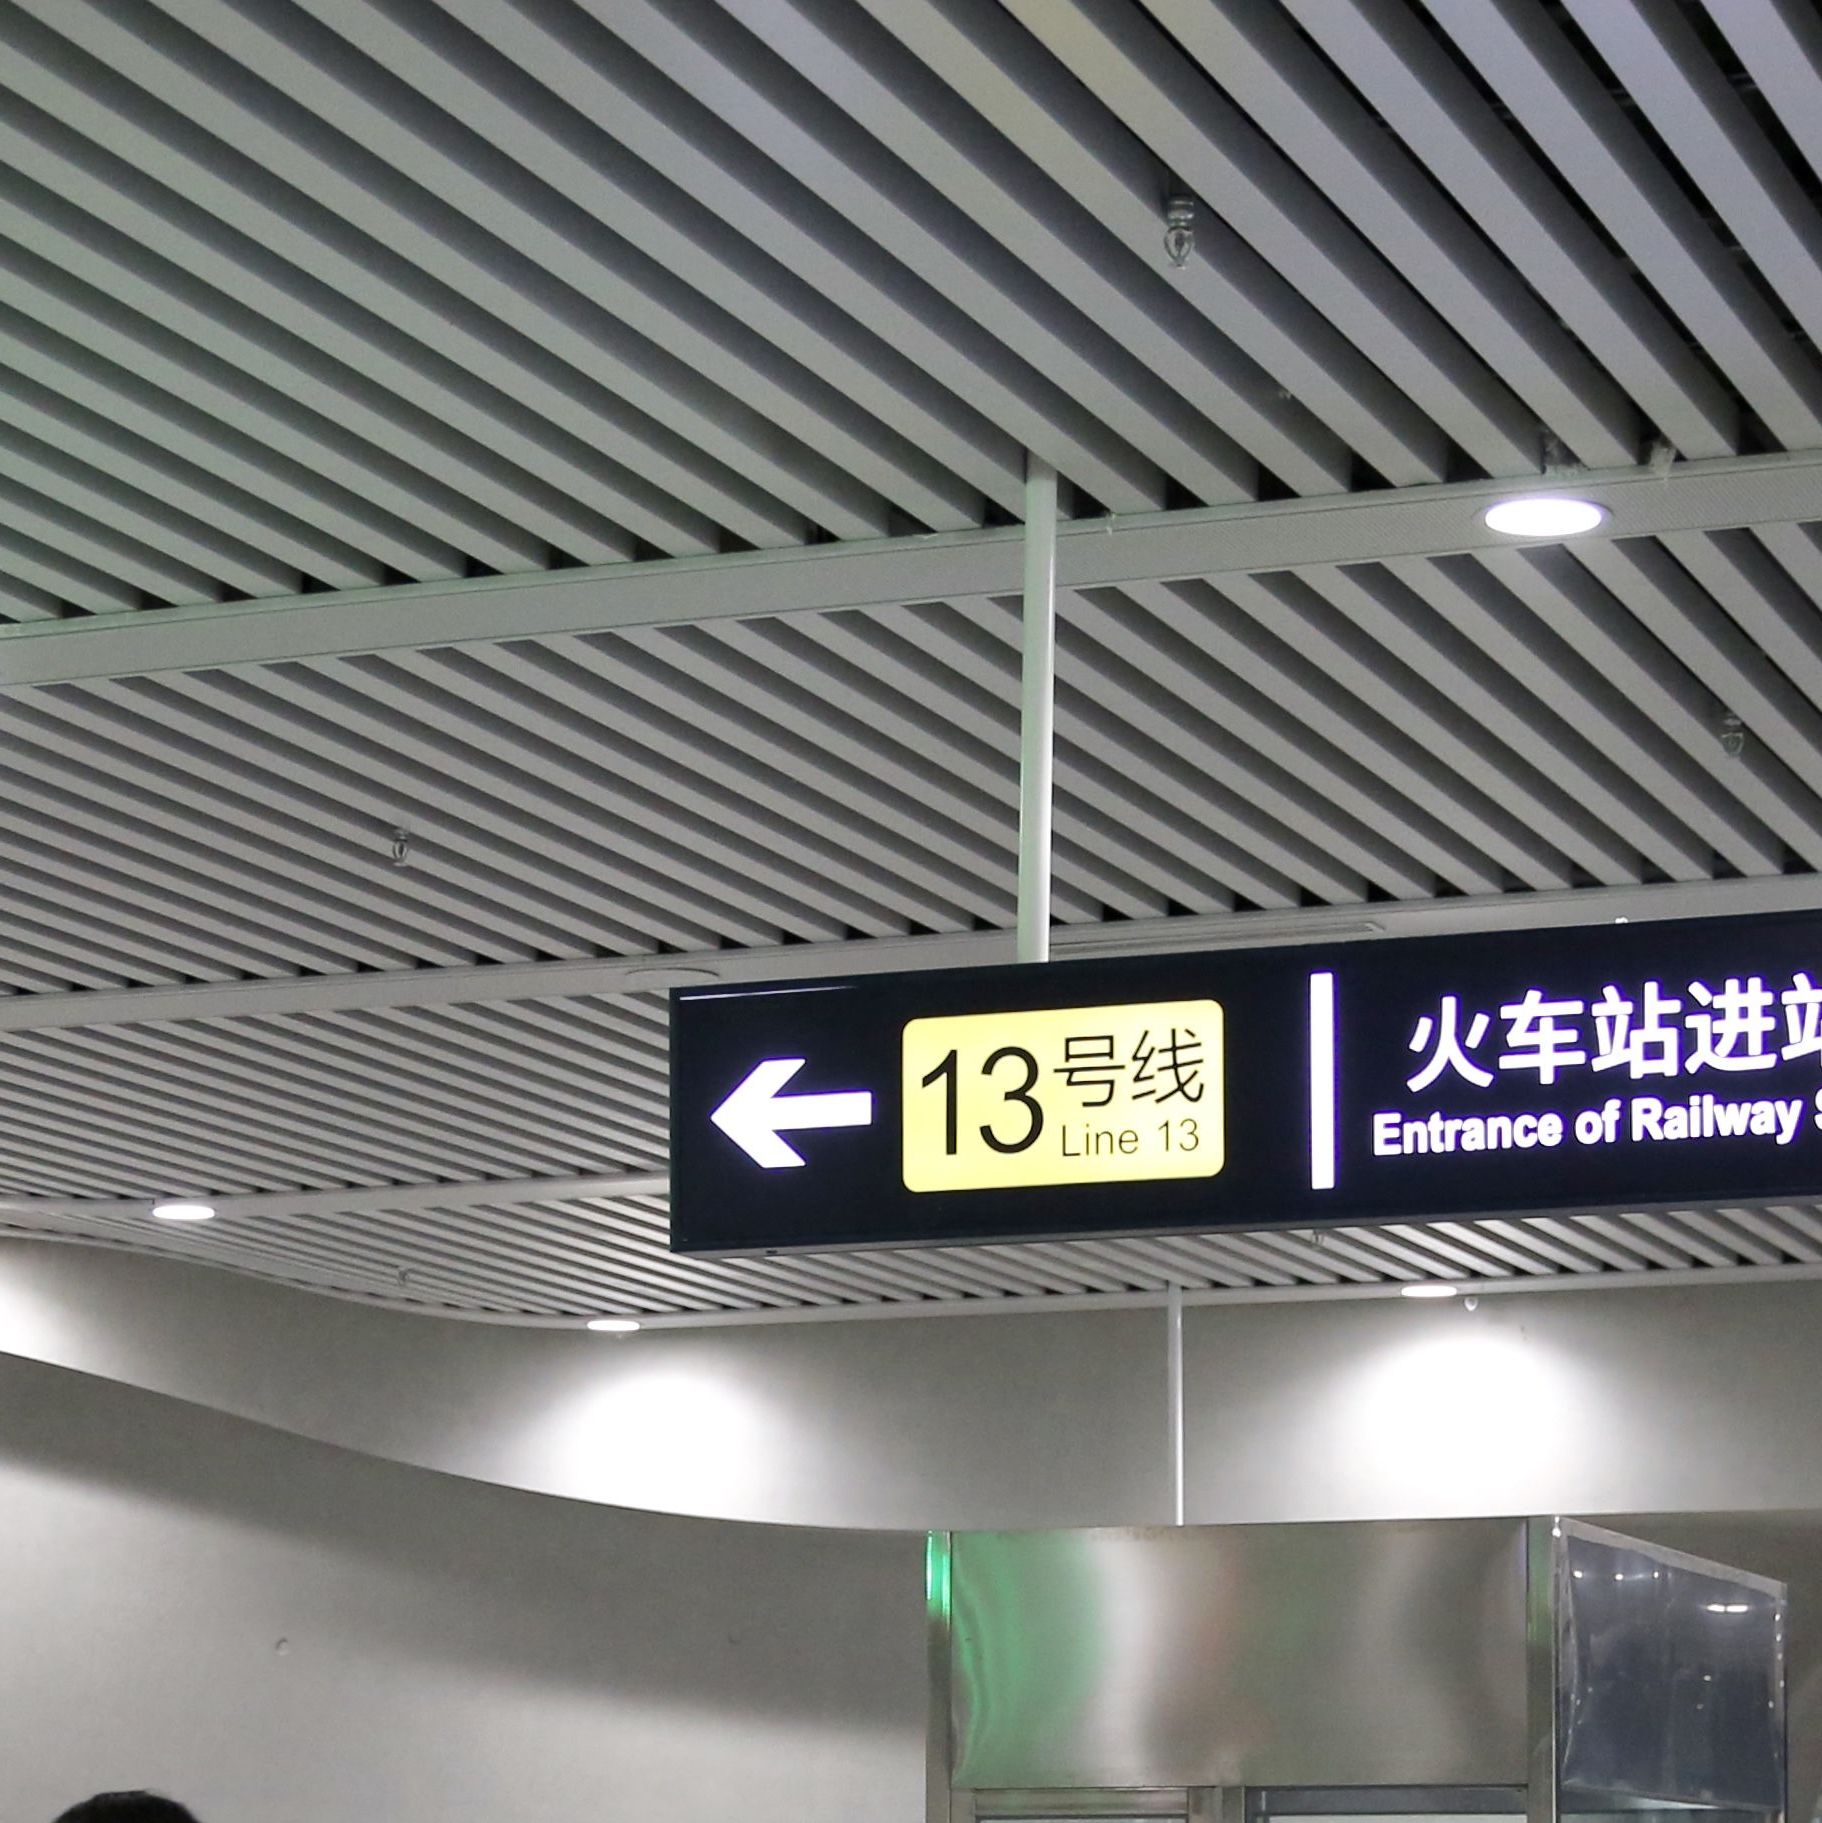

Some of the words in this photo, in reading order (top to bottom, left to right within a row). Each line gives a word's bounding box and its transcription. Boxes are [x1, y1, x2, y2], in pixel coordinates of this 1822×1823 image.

[1061, 1123, 1139, 1157] Line
[1157, 1118, 1200, 1152] 13
[1372, 1111, 1564, 1156] Entrance
[1574, 1098, 1622, 1145] of
[1630, 1093, 1802, 1145] Railway
